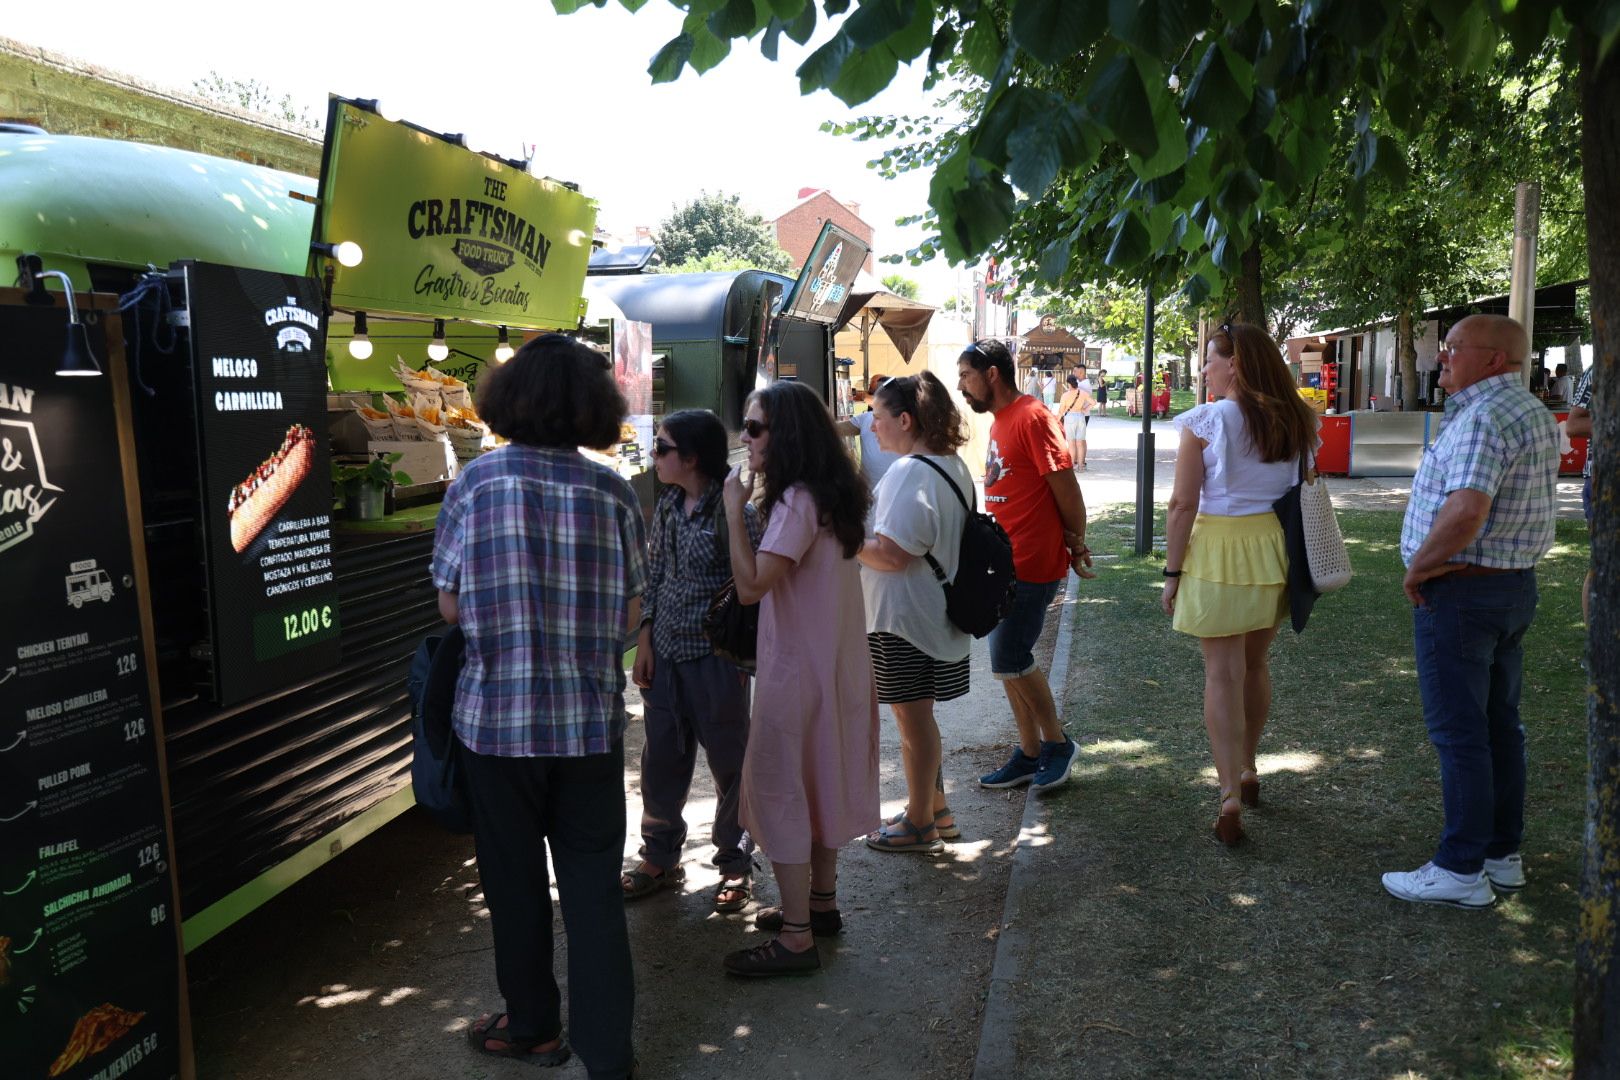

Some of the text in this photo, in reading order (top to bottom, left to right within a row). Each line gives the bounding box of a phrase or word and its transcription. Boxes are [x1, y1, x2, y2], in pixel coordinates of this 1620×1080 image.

[484, 176, 508, 201] THE
[408, 199, 552, 269] CRAFTSMAN
[458, 242, 510, 266] FOOD TRUCK
[480, 276, 529, 312] Bocatas
[265, 306, 319, 330] CRAFTSMAN
[212, 357, 258, 378] MELOSO
[215, 391, 283, 411] CARRILLERA
[1, 437, 26, 472] &
[278, 519, 311, 533] CARRILLERA
[309, 529, 331, 542] TOMATE
[294, 545, 324, 561] MAYONESA
[263, 567, 292, 582] MOSTAZA
[304, 572, 333, 587] CEBOLLINO
[284, 605, 332, 641] 12.00 €
[17, 640, 55, 660] CHICKEN
[55, 632, 89, 651] TERIYAKI
[116, 652, 137, 676] 12€
[26, 702, 62, 722] MELOSO
[63, 688, 108, 712] CARRILLERA
[123, 718, 146, 741] 12€
[38, 768, 68, 791] PULLED
[69, 762, 91, 779] PORK
[38, 839, 79, 859] FALAFEL
[137, 842, 160, 868] 12€
[43, 889, 90, 917] SALCHICHA
[92, 873, 132, 897] AHUMADA
[150, 904, 166, 926] 9€
[143, 1032, 157, 1056] 5€
